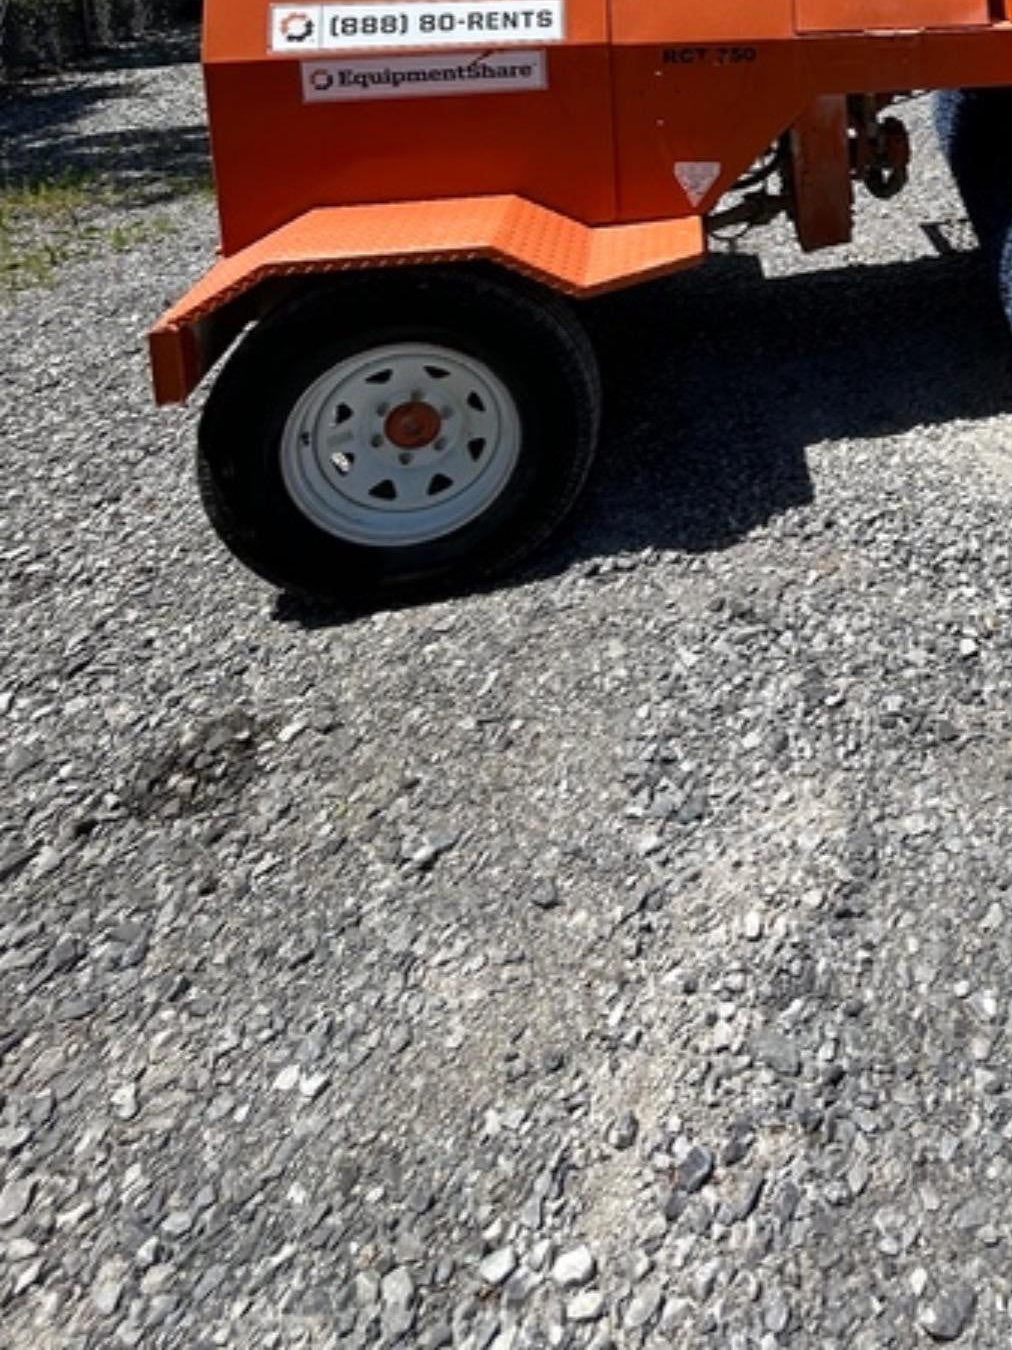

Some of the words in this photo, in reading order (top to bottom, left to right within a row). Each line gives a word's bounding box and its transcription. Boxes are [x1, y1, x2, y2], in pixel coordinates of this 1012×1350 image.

[329, 13, 409, 37] (888)
[418, 8, 554, 33] 80-RENTS
[338, 61, 533, 90] EquipmentShare
